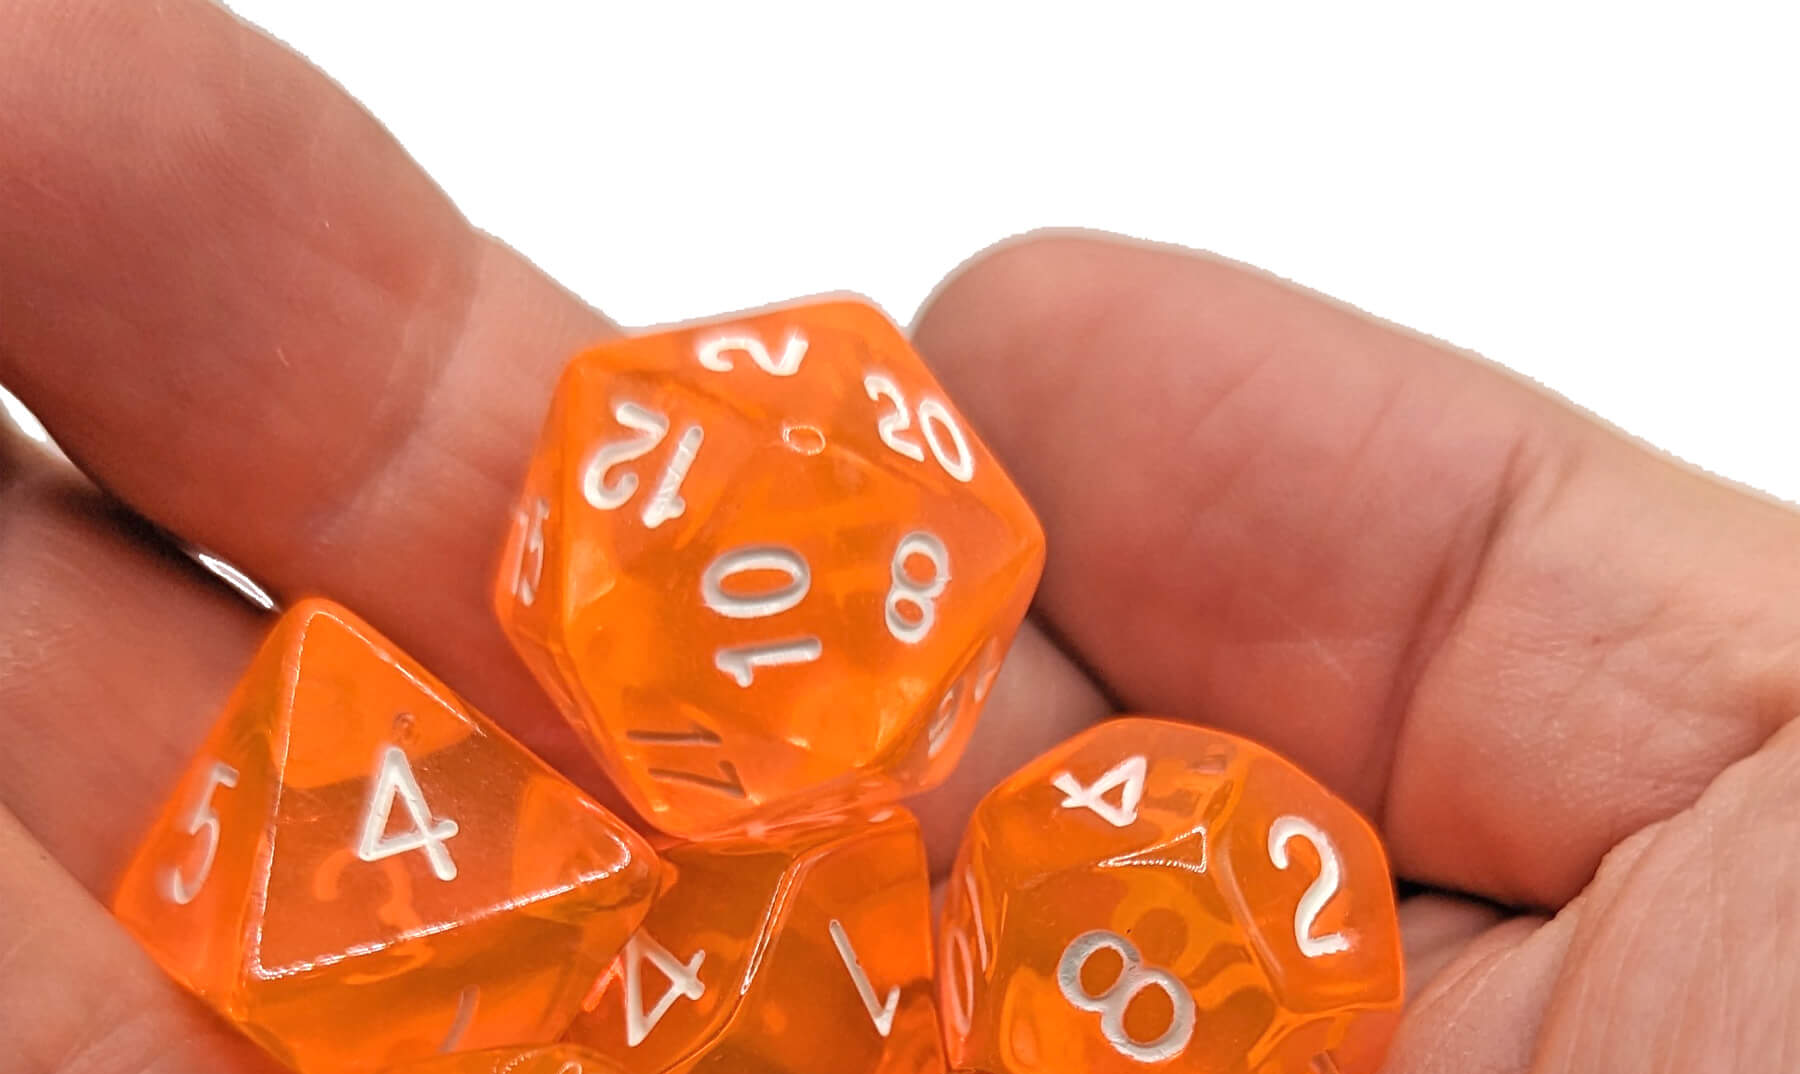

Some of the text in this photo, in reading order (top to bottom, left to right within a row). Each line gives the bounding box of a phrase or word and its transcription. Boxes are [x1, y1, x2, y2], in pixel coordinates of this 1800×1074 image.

[697, 328, 808, 377] 2
[583, 401, 704, 529] 12
[864, 374, 975, 484] 20
[702, 543, 823, 688] 10
[885, 531, 950, 645] 8
[358, 744, 460, 881] 4
[626, 721, 747, 800] 17
[1050, 753, 1148, 828] 4
[160, 759, 240, 906] 5
[1266, 814, 1356, 959] 2
[624, 926, 706, 1048] 4
[1056, 928, 1197, 1064] 8
